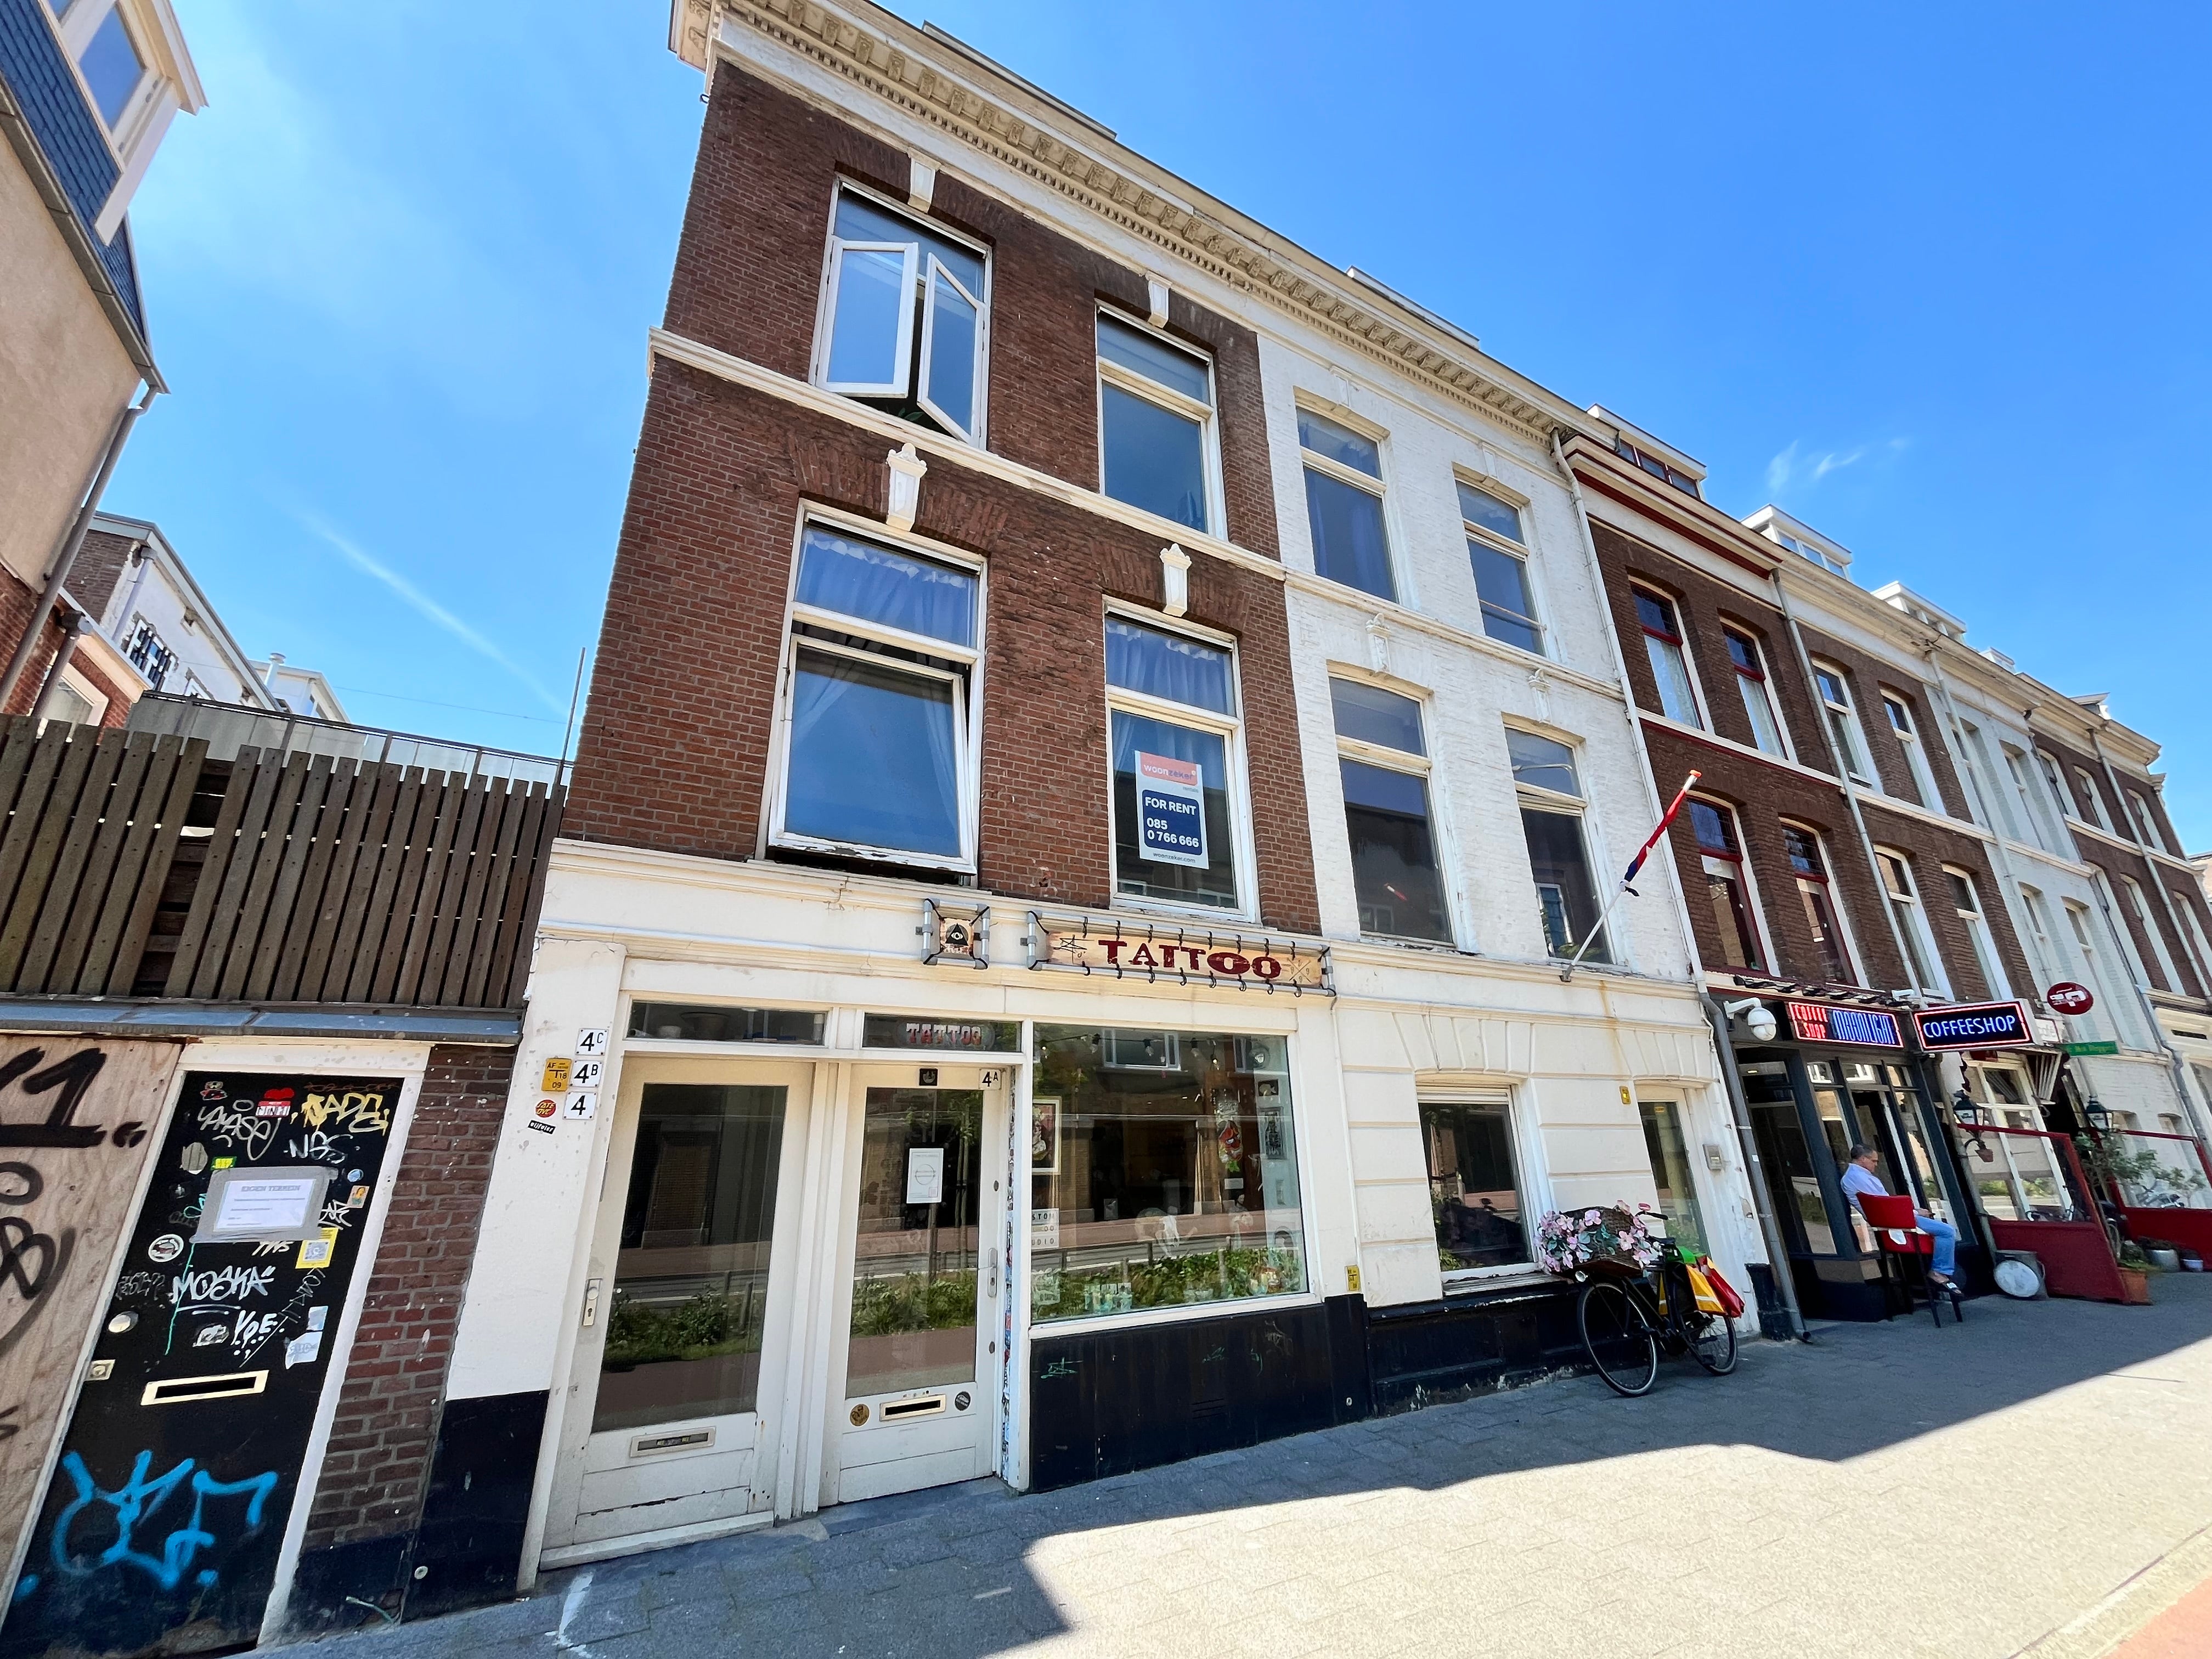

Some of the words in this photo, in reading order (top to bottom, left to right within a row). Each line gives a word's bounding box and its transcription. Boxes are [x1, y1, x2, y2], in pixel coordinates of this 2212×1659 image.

[1144, 797, 1167, 810] FOR
[1169, 801, 1197, 815] RENT
[1146, 817, 1168, 830] 085
[1147, 830, 1155, 840] 0
[1156, 832, 1177, 844] 766
[1178, 836, 1200, 848] 666
[1153, 852, 1196, 864] woonzeker.com
[1098, 939, 1282, 979] TATTOO
[906, 1023, 982, 1046] TATTOO
[1922, 1015, 2016, 1038] COFFEESHOP
[571, 1094, 586, 1115] 4
